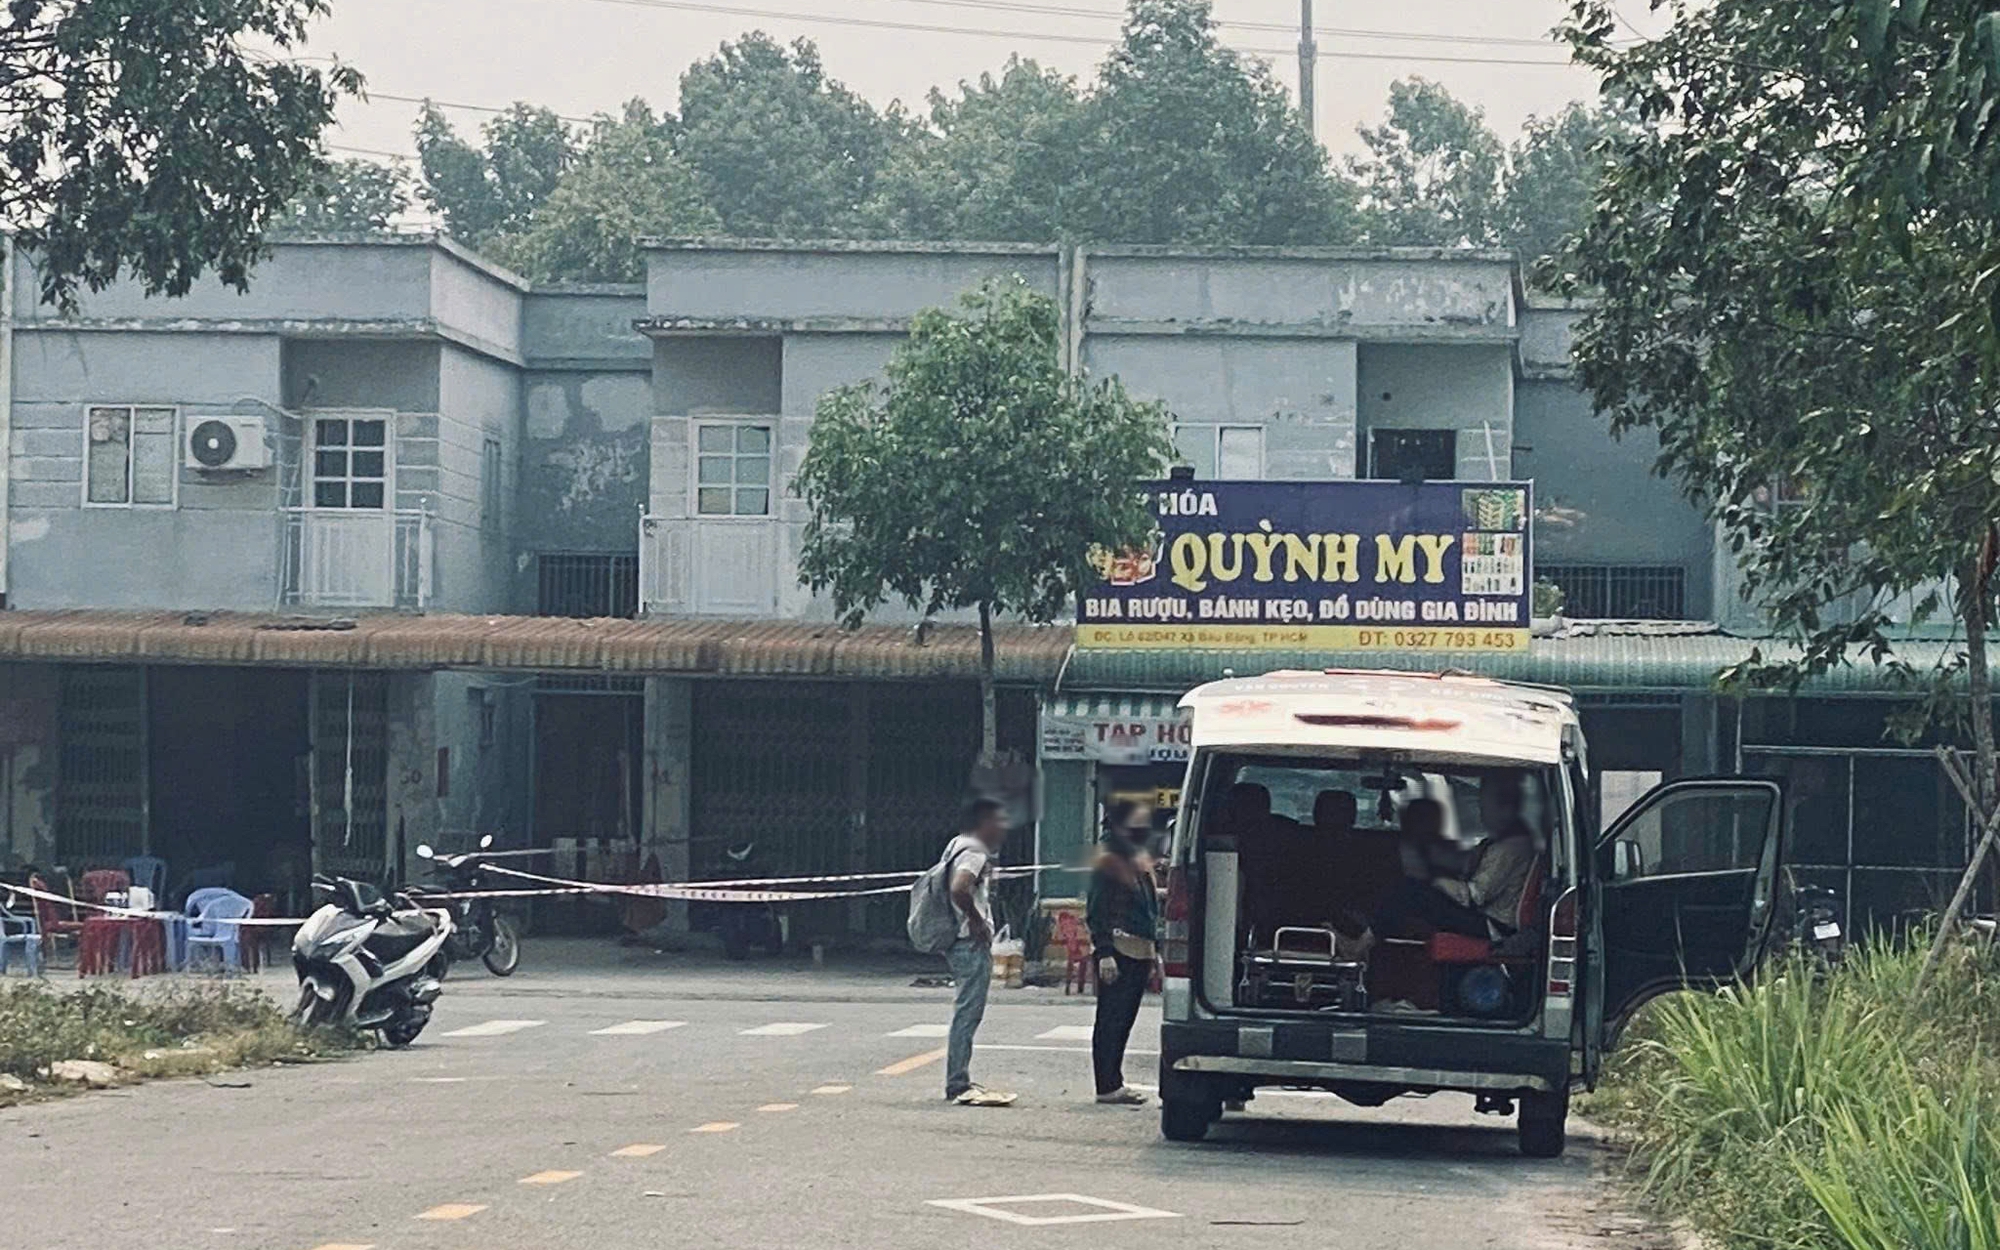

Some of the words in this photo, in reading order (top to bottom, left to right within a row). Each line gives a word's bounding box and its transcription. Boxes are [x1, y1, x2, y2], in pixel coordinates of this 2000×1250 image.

[1158, 488, 1219, 516] HÓA
[1170, 518, 1360, 593] QUỲNH
[1374, 534, 1455, 583] MY
[1085, 598, 1123, 617] BIA
[1128, 597, 1193, 621] RƯỢU,
[1199, 595, 1259, 619] BÁNH
[1265, 599, 1314, 622] KẸO,
[1355, 596, 1416, 620] DÙNG
[1421, 600, 1459, 621] GIA
[1464, 598, 1518, 622] ĐÌNH
[1359, 630, 1387, 646] ĐT:
[1394, 631, 1438, 647] 0327
[1445, 632, 1476, 648] 793
[1482, 632, 1515, 648] 453
